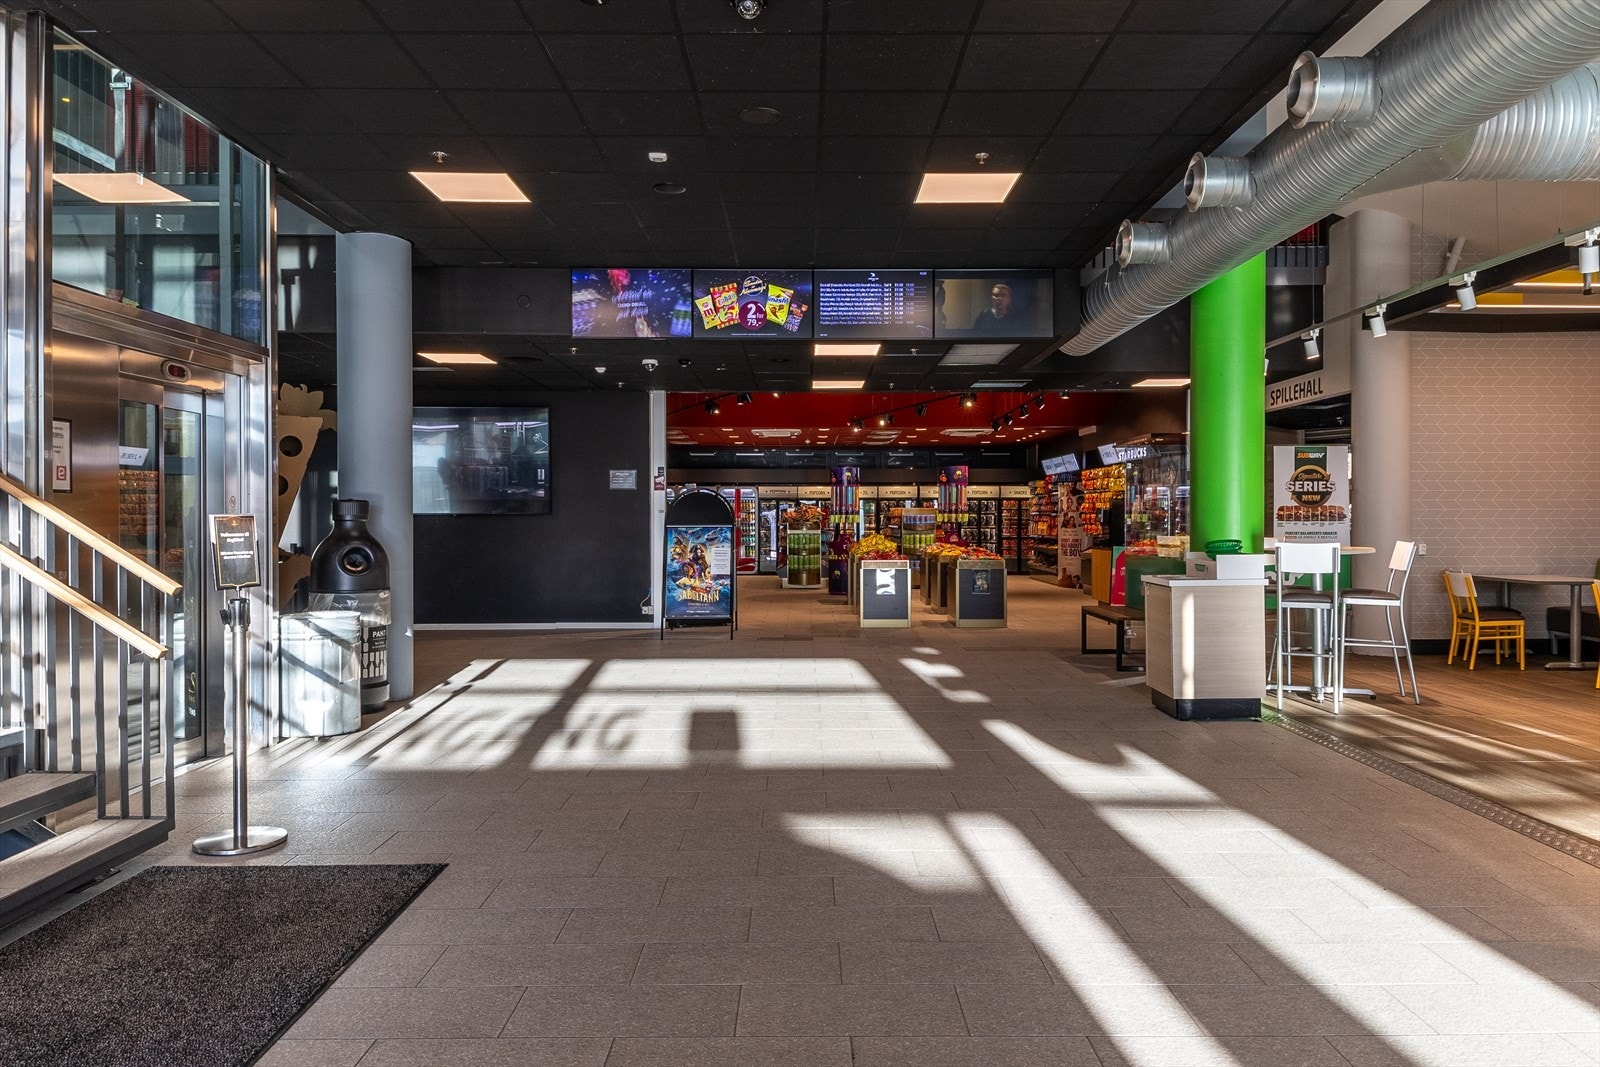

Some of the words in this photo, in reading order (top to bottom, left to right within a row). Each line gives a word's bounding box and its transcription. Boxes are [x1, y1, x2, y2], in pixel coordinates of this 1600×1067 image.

[747, 303, 756, 318] 2
[1271, 377, 1323, 406] SPILLEHALL
[1118, 447, 1147, 461] STARBUCKS
[1286, 480, 1336, 492] SERIES
[1302, 494, 1320, 502] NEW
[1060, 548, 1069, 557] THE
[1068, 548, 1082, 557] BOY
[677, 588, 720, 603] SABELTANN
